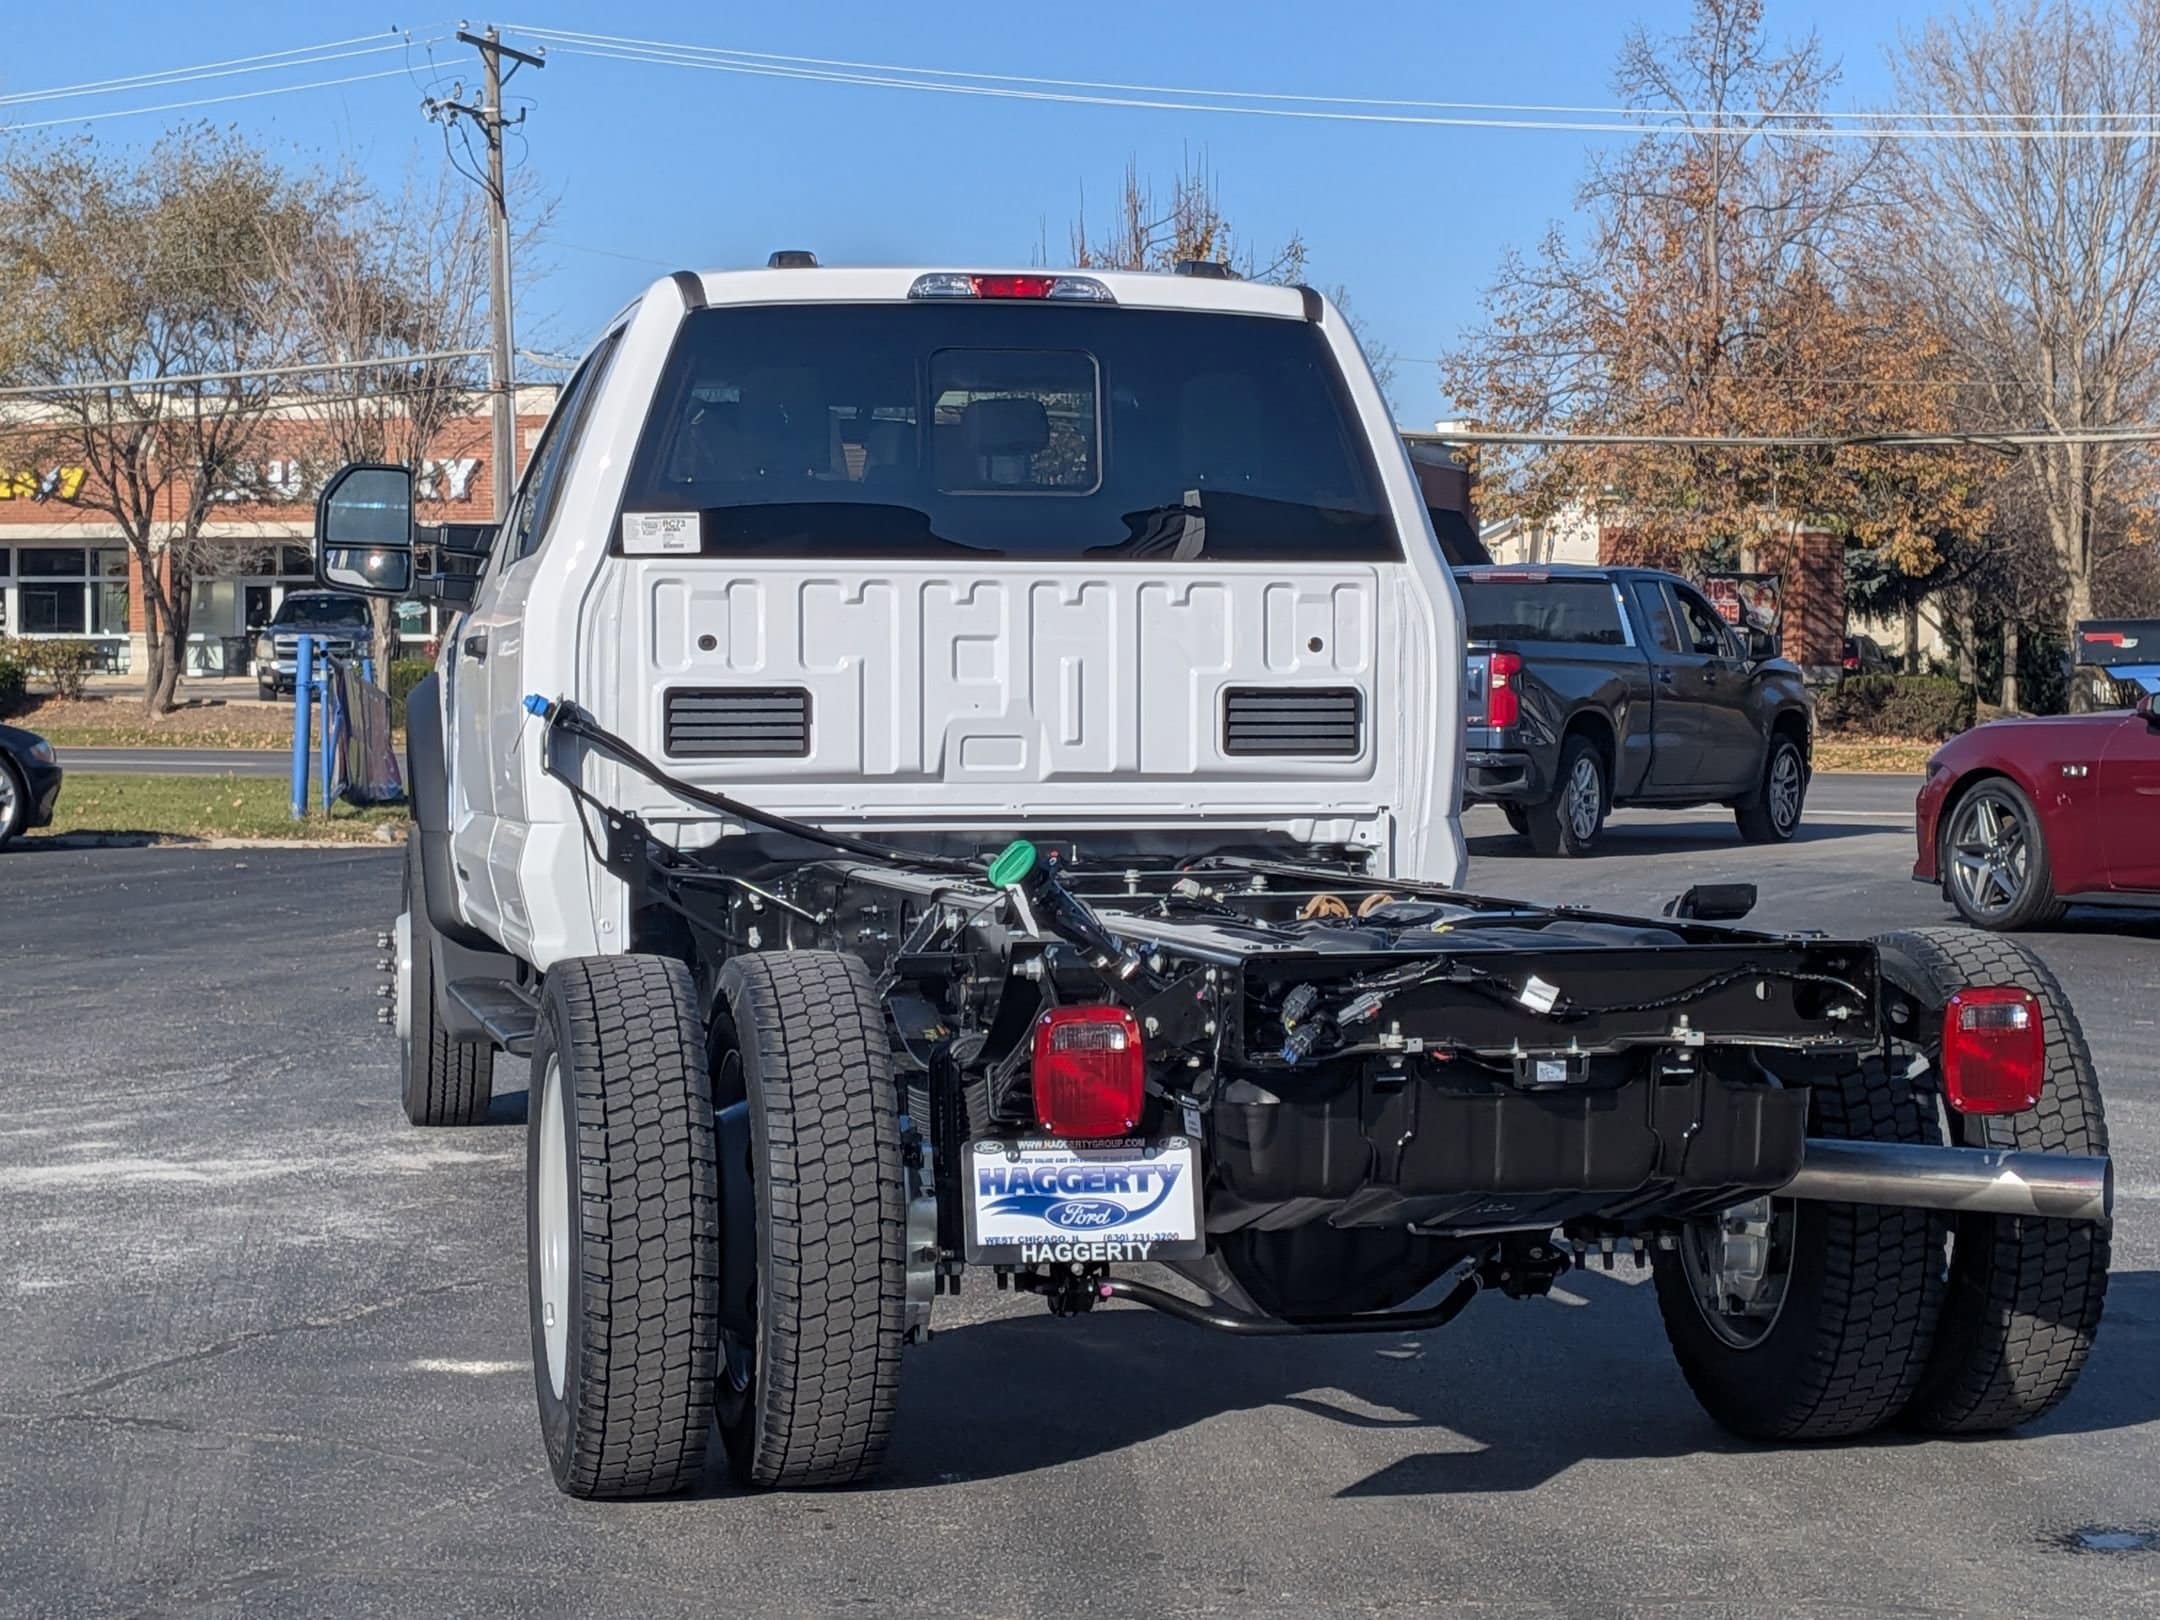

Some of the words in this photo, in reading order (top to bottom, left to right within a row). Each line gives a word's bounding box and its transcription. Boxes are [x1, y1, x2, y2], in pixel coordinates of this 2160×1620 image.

[979, 1164, 1183, 1196] HAGGERTY
[1060, 1203, 1112, 1225] Ford
[985, 1236, 1013, 1246] WEST
[1021, 1243, 1152, 1263] HAGGERTY
